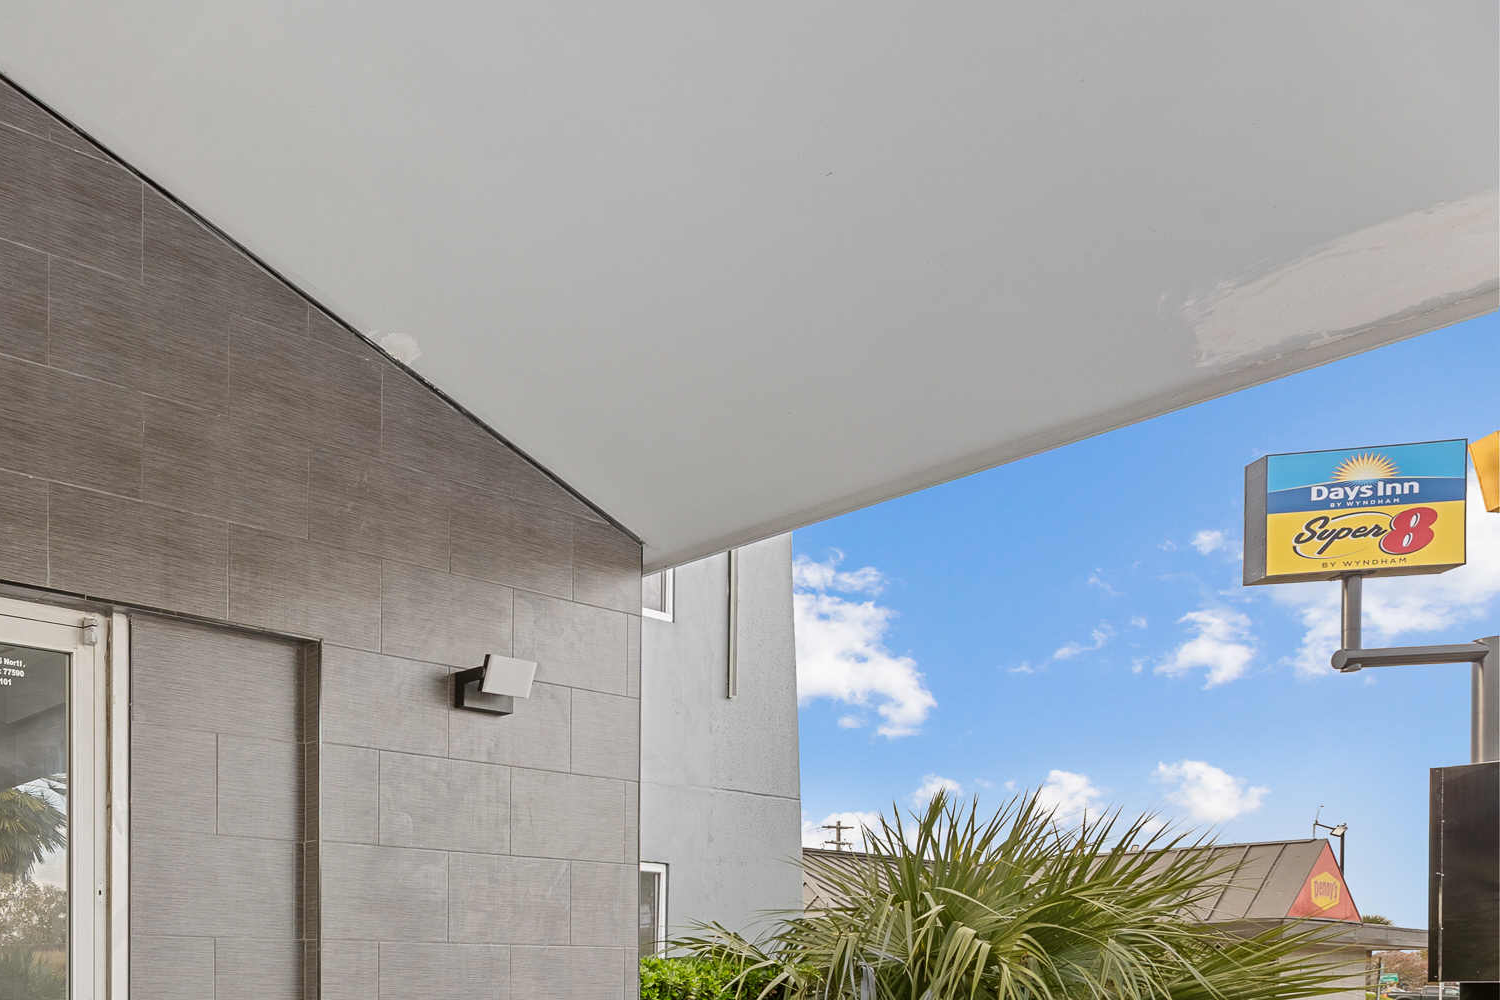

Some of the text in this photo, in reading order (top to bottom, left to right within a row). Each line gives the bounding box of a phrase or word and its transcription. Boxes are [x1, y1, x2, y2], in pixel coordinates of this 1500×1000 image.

[1311, 481, 1420, 501] Days Inn
[1346, 498, 1400, 507] WYNDHAM
[1293, 507, 1438, 556] Super 8
[1343, 557, 1407, 567] WYNDHAM
[3, 668, 25, 677] 77590
[1314, 880, 1338, 900] Denny's
